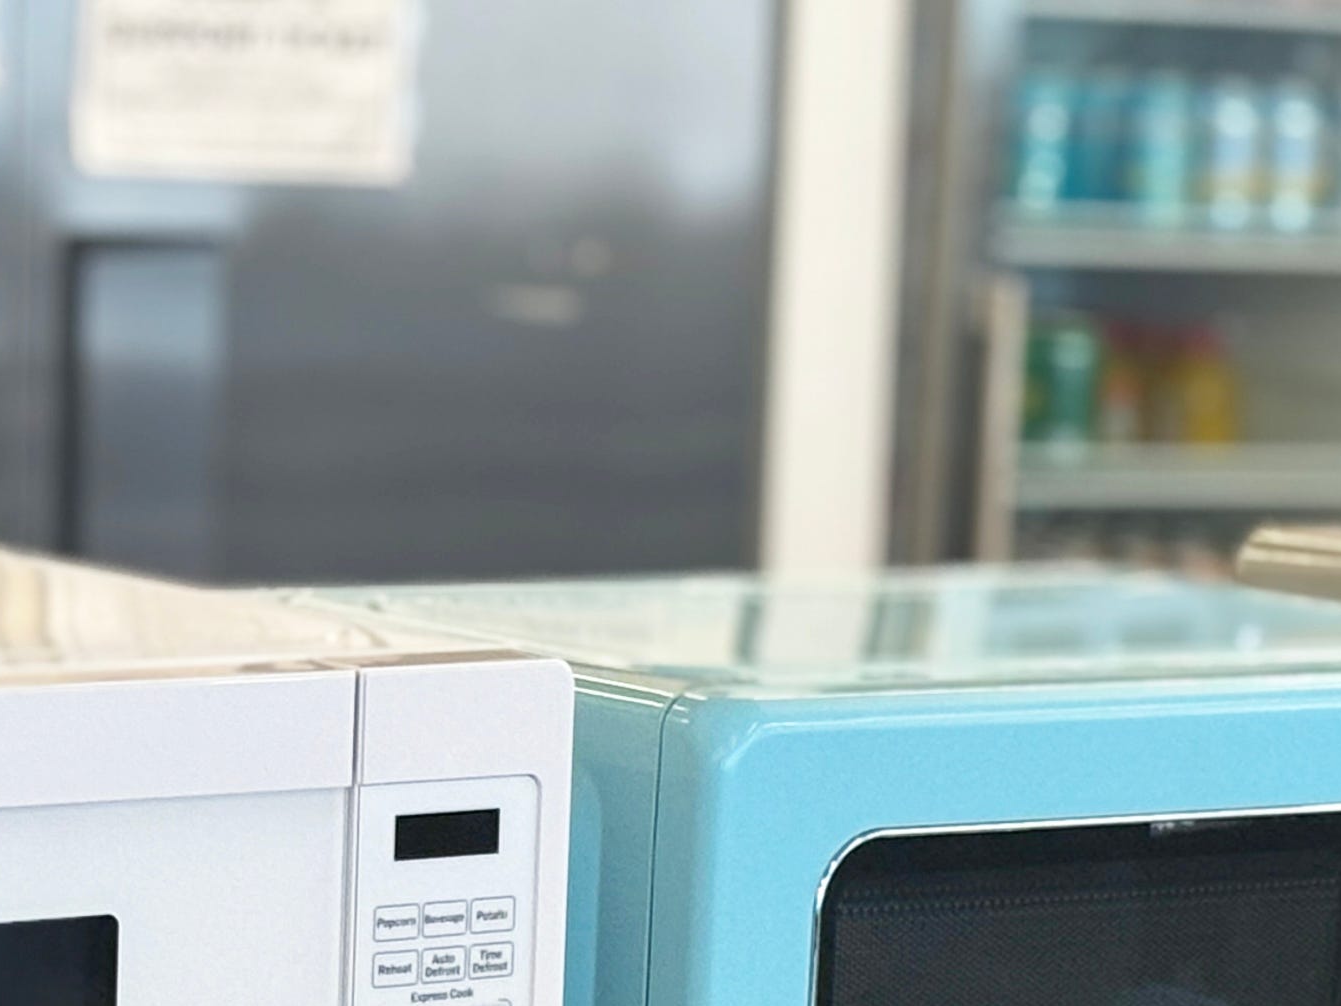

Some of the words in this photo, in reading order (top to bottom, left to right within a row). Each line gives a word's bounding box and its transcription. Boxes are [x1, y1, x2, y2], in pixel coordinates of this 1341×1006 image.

[424, 913, 464, 924] Beverage
[476, 910, 508, 921] Potato
[377, 917, 416, 929] Popcorn
[432, 954, 456, 964] Auto
[480, 949, 503, 960] Time
[378, 963, 412, 975] Reheat
[425, 966, 460, 978] Defrost
[473, 961, 508, 973] Defrost
[411, 991, 448, 1003] Express
[450, 988, 473, 999] Cook
